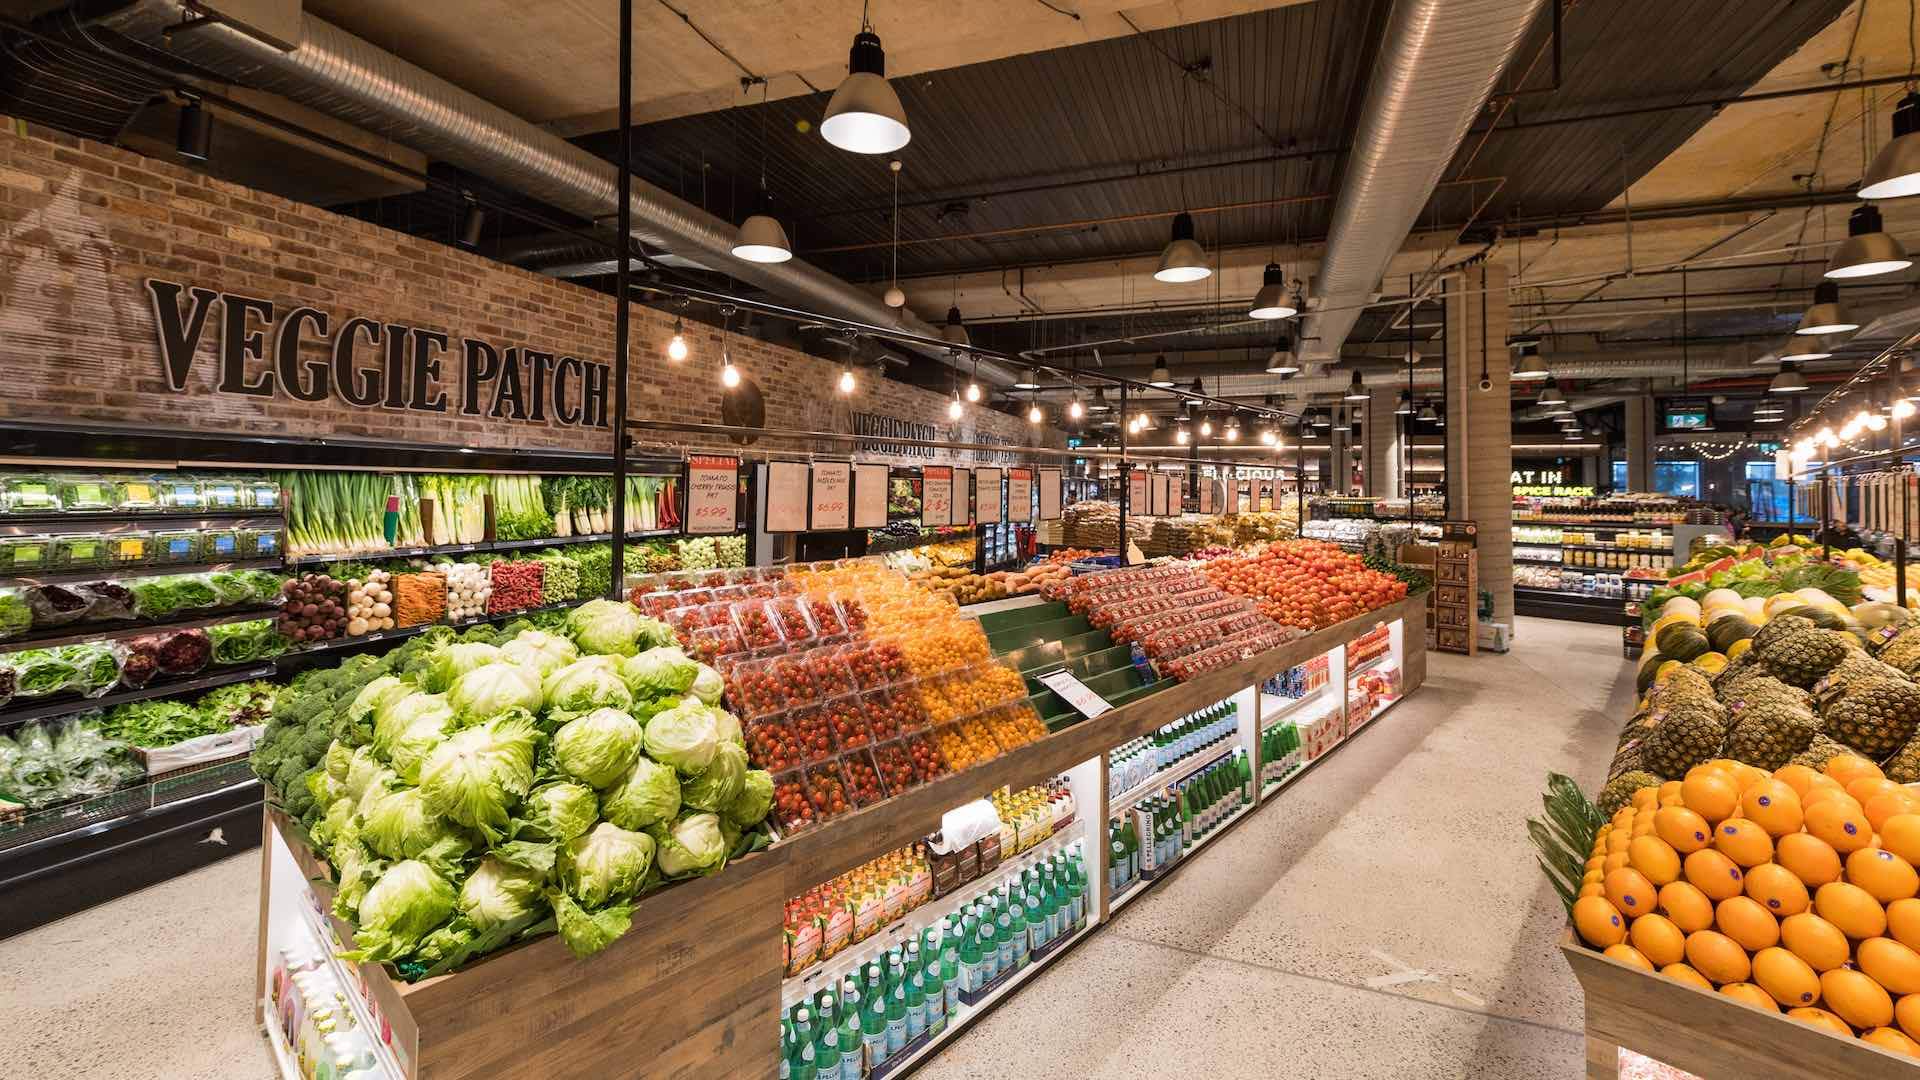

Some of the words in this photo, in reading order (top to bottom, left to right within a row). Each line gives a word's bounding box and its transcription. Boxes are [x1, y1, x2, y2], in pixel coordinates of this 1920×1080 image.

[146, 278, 449, 413] VEGGIE
[461, 337, 609, 428] PATCH
[699, 473, 729, 482] TOMATO
[1541, 471, 1562, 484] IN
[1513, 486, 1551, 496] SPICE
[1554, 486, 1594, 496] RACK
